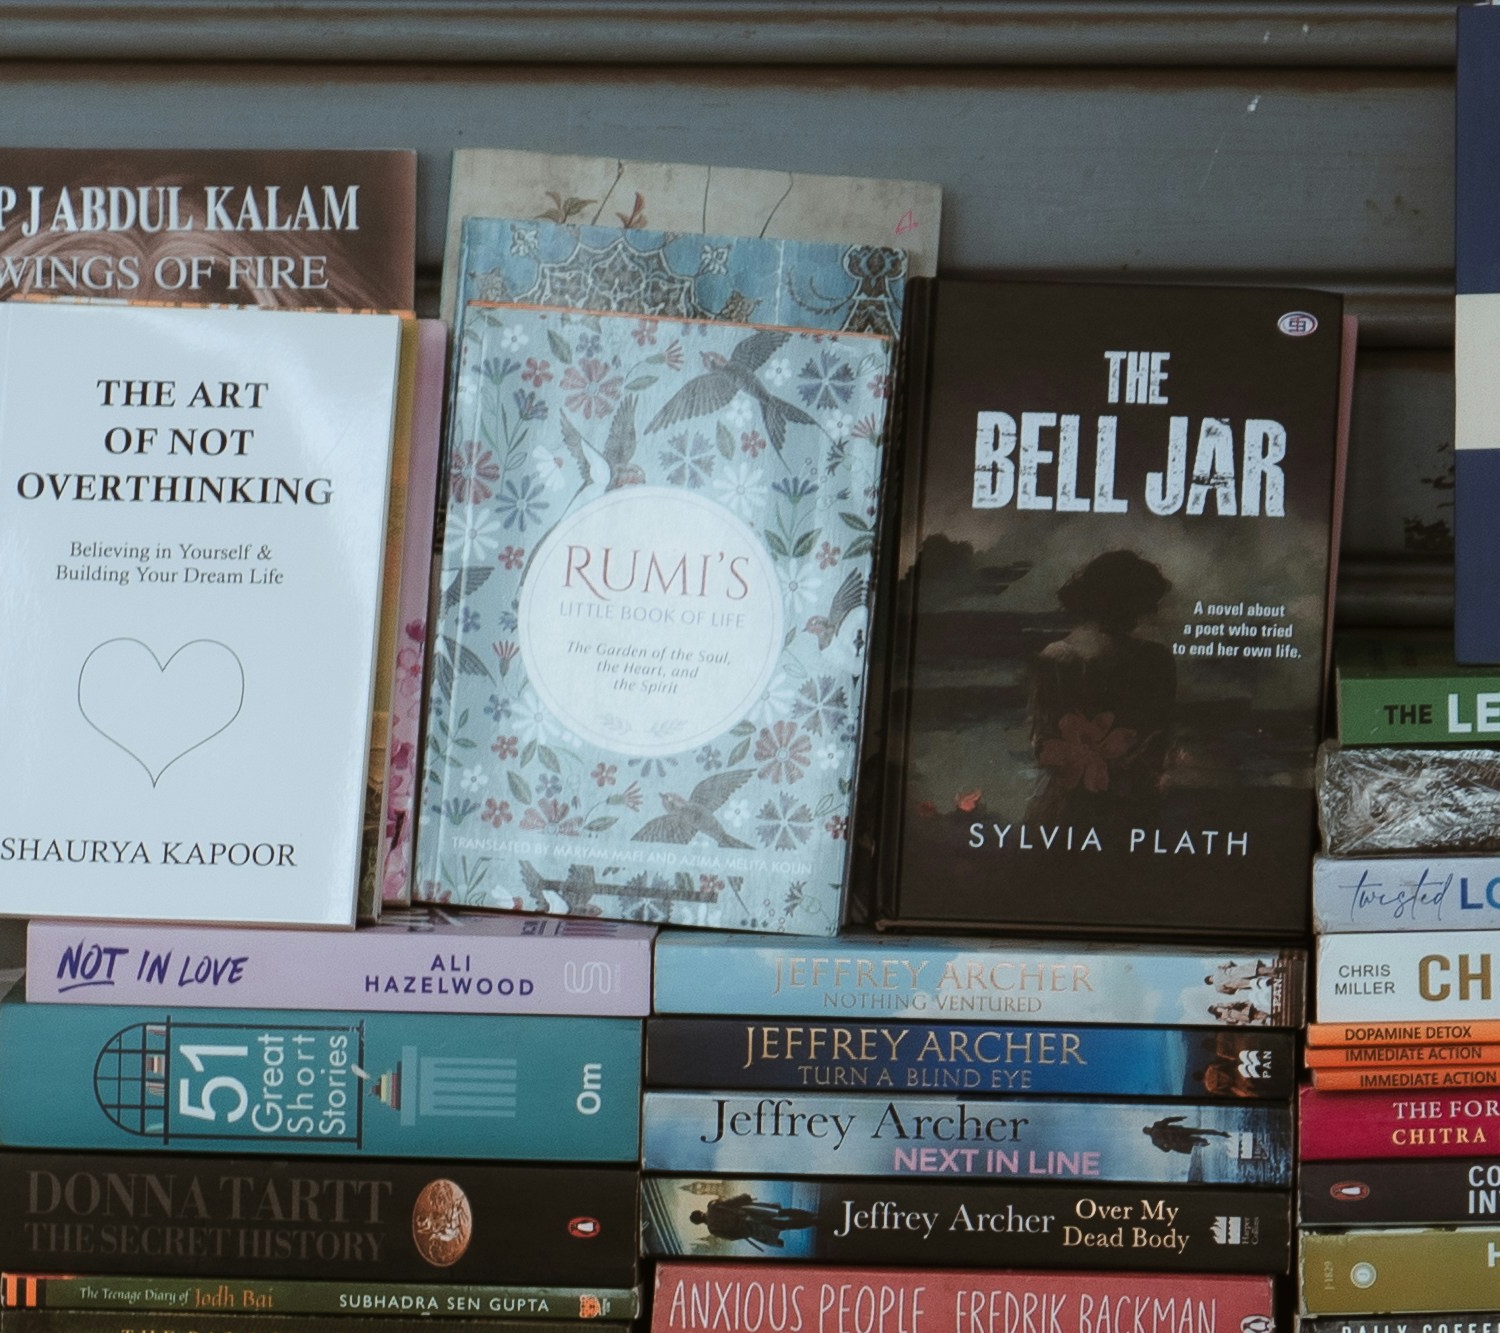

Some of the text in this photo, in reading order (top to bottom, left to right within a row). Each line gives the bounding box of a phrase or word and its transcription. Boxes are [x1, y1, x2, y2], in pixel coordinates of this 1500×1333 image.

[52, 186, 360, 233] ABDUL KALAM
[154, 256, 215, 290] OF
[227, 256, 329, 290] FIRE
[97, 379, 269, 409] THE ART
[1105, 351, 1168, 405] THE
[105, 428, 254, 456] OF NOT
[973, 412, 1285, 518] BELL JAR
[16, 473, 334, 506] OVERTHINKING
[55, 566, 284, 586] Building Your Dream Life
[0, 838, 297, 867] SHAURYA KAPOOR
[969, 823, 1249, 858] SYLVIA PLATH
[57, 940, 248, 992] NOT IN LOVE
